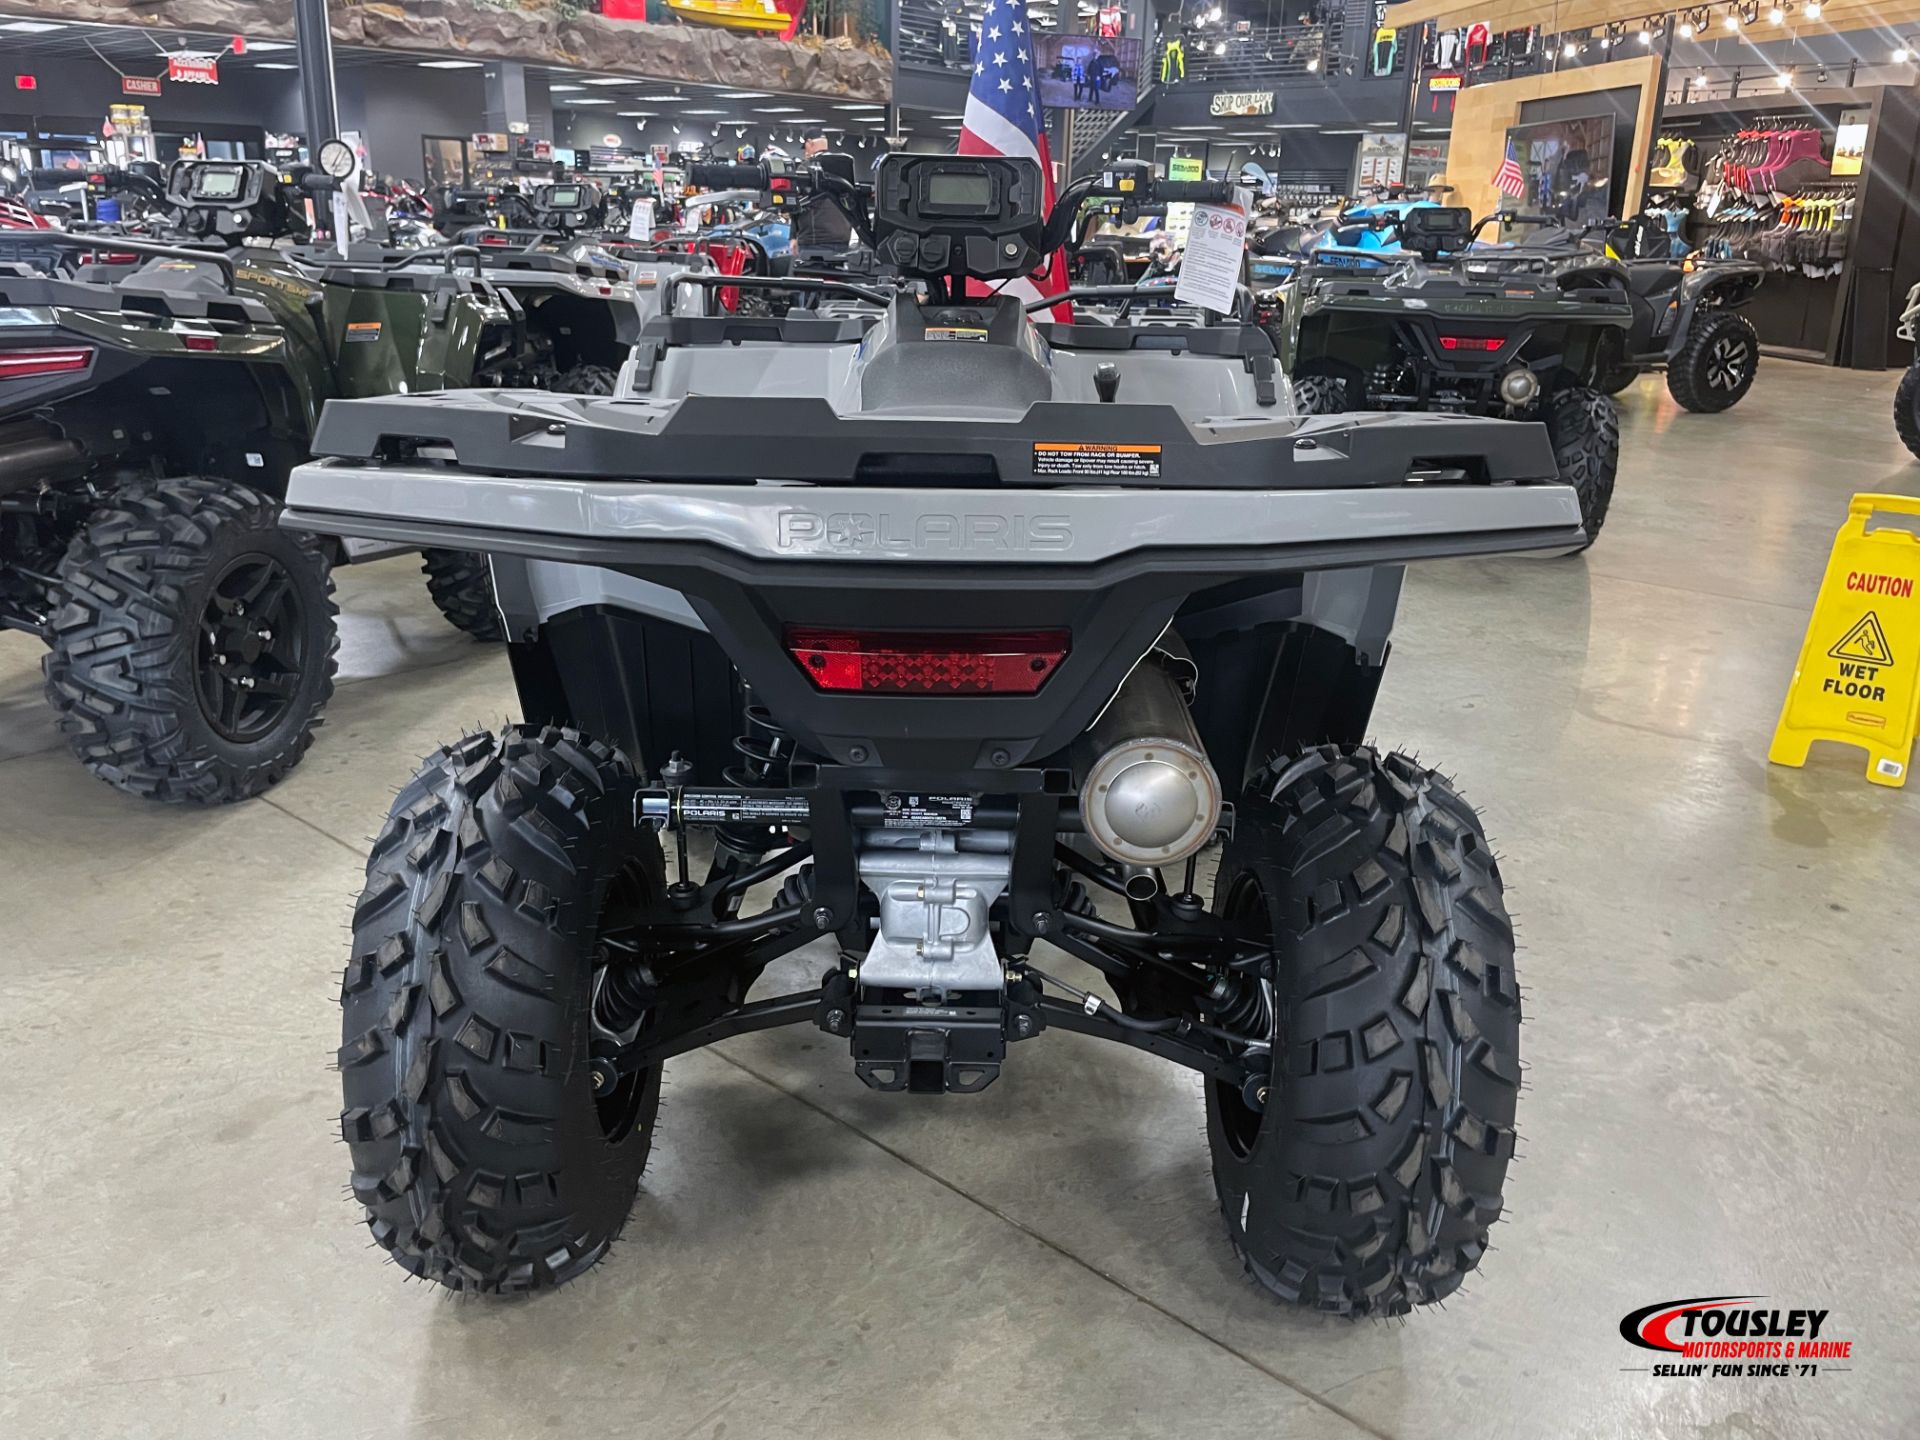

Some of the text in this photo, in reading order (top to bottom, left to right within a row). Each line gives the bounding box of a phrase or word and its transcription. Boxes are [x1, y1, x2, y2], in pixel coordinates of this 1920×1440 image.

[126, 79, 158, 92] CASHIER
[1212, 95, 1234, 113] SHOP
[1236, 93, 1253, 108] OUR
[236, 268, 310, 297] SPORTSM
[777, 511, 1075, 550] POLARIS
[1846, 571, 1914, 598] CAUTION
[1838, 662, 1879, 681] WET
[1823, 678, 1885, 702] FLOOR
[683, 809, 726, 817] POLARIS
